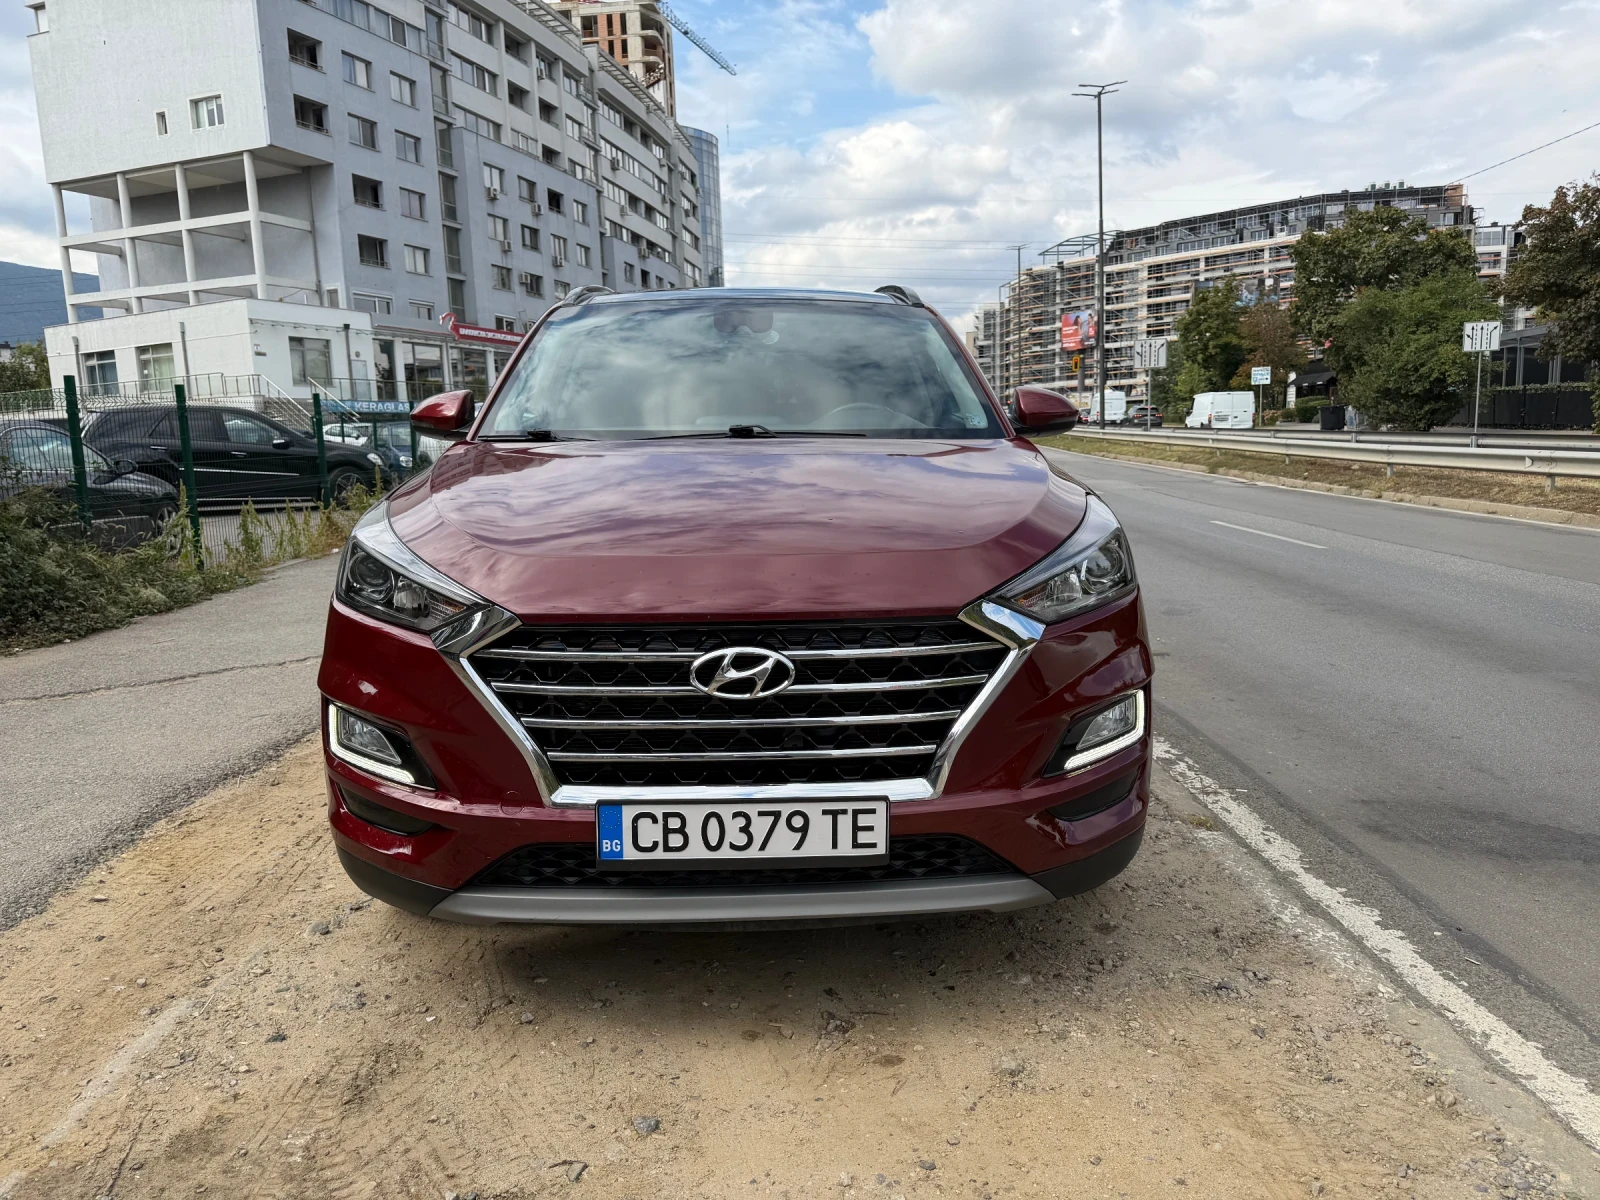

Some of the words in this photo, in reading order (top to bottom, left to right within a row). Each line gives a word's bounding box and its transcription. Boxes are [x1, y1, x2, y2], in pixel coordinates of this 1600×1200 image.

[354, 402, 416, 412] KERAGLAS
[631, 811, 690, 853] CB
[701, 809, 810, 852] 0379
[821, 807, 878, 850] TE
[602, 839, 621, 852] BG
